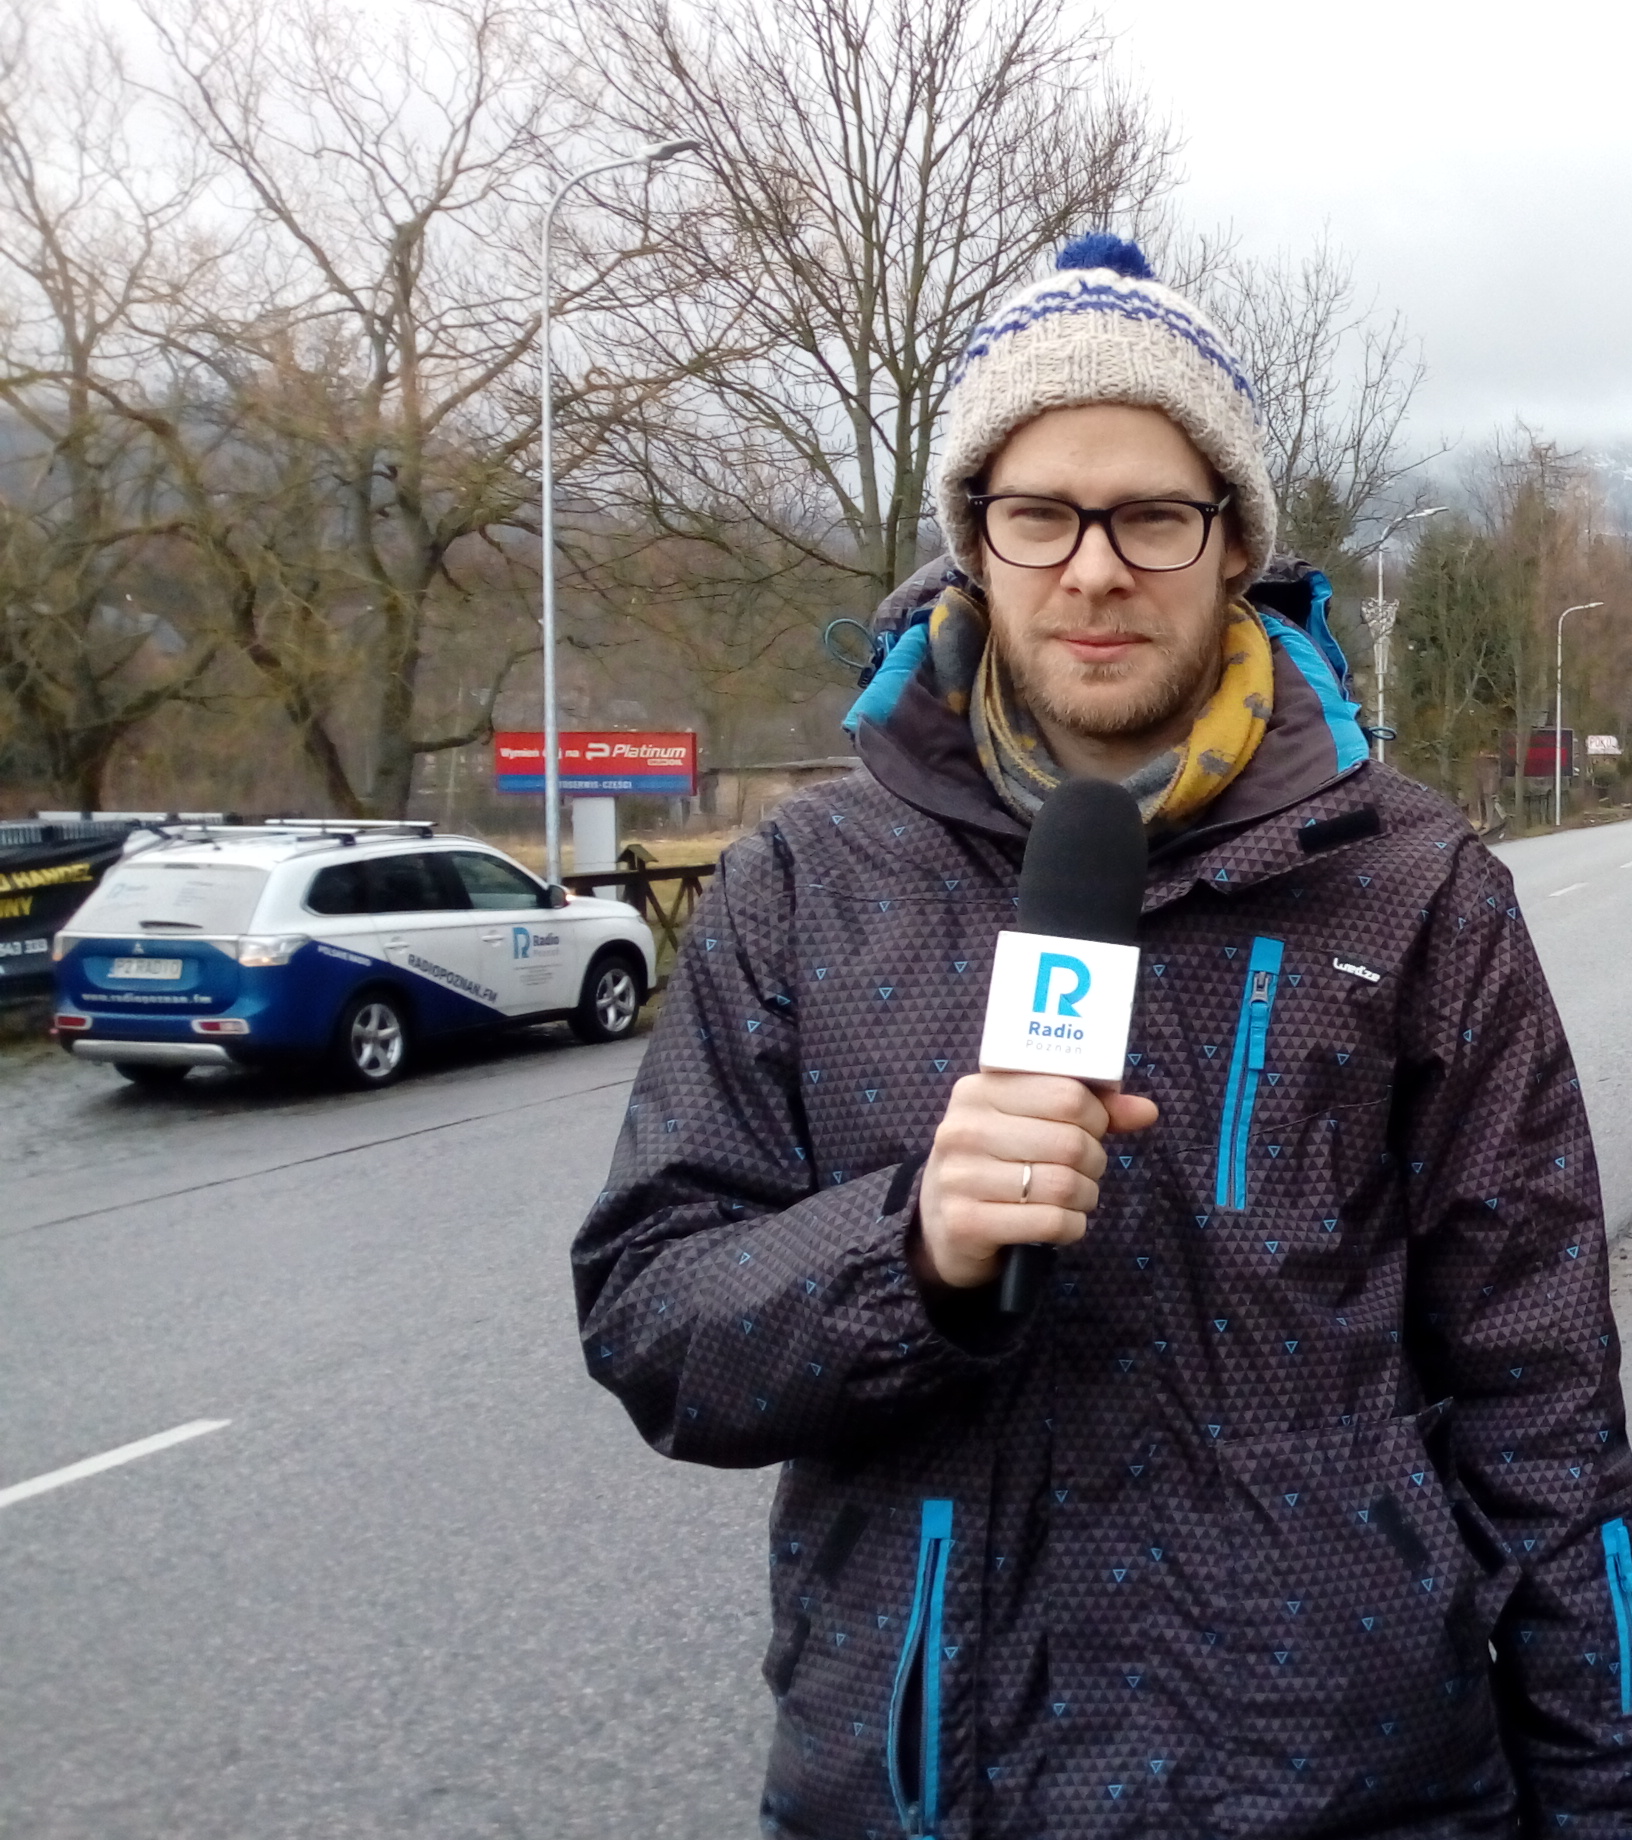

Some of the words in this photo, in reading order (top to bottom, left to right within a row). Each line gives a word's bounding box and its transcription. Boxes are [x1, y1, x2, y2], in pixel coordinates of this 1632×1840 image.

[612, 744, 687, 758] Platinum
[533, 933, 559, 946] Radio
[1028, 1021, 1084, 1040] Radio
